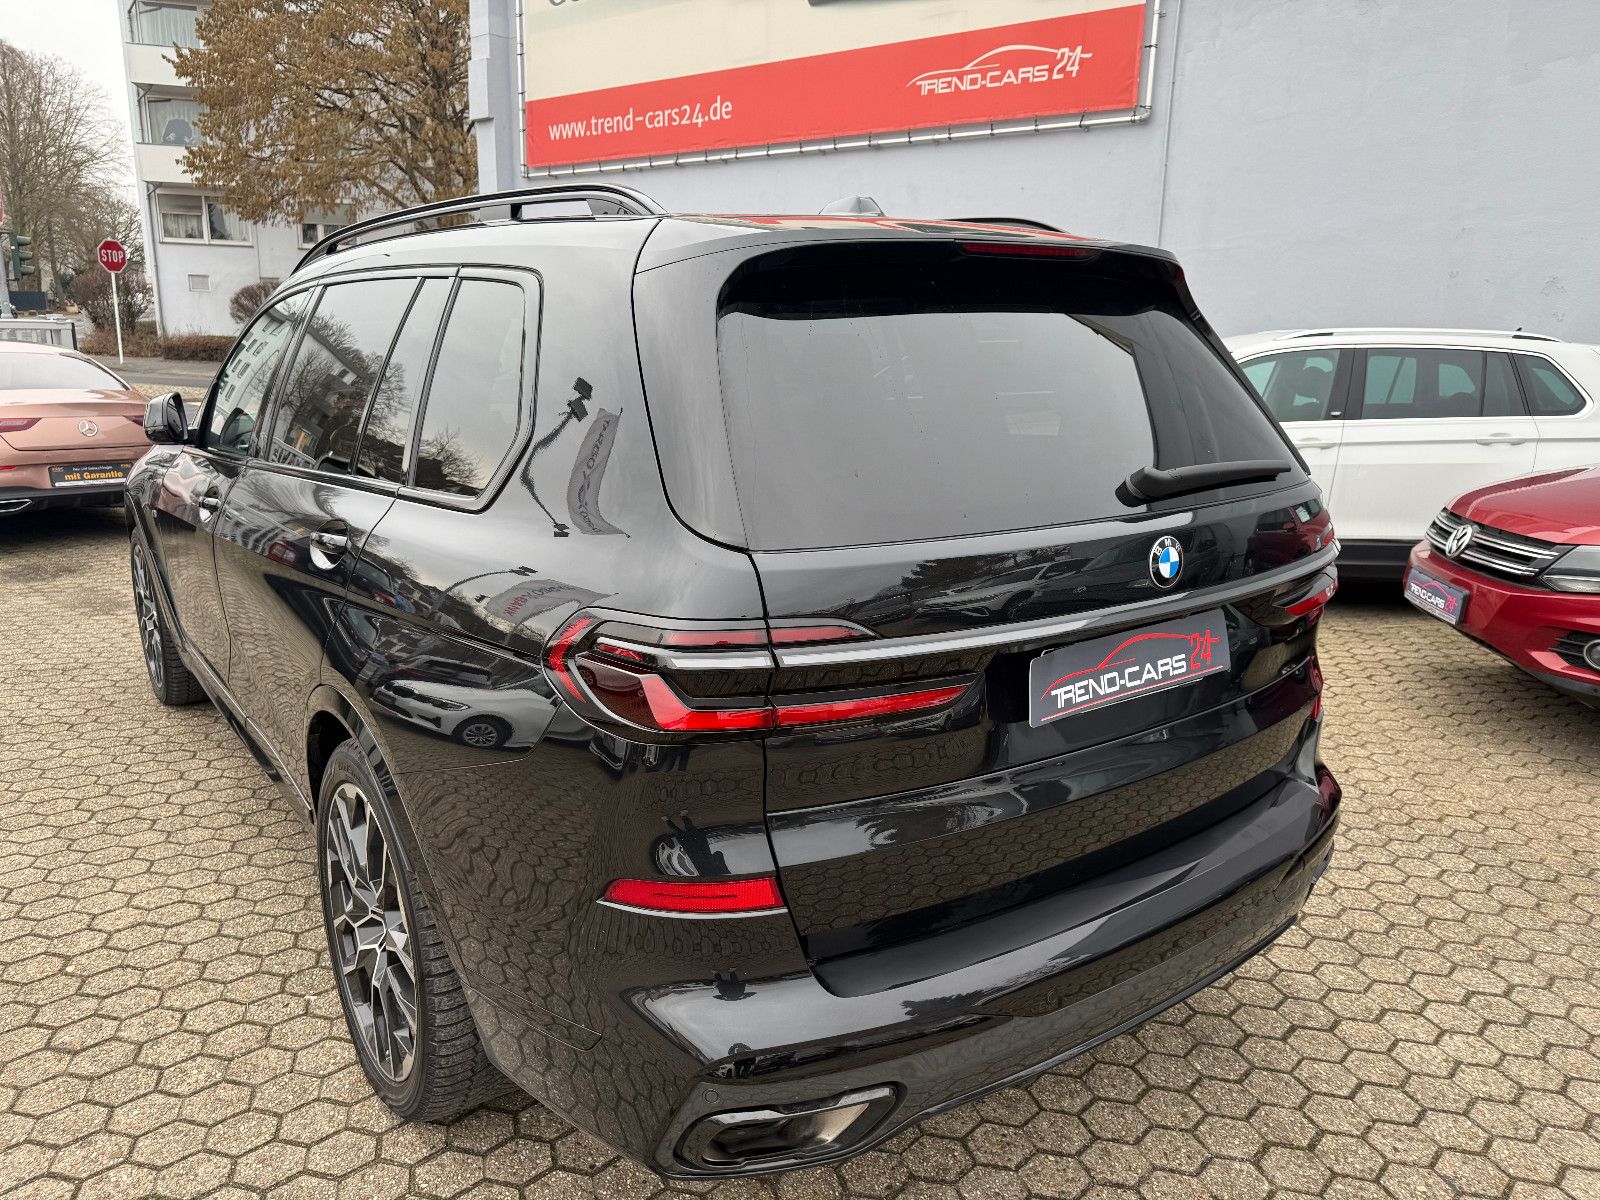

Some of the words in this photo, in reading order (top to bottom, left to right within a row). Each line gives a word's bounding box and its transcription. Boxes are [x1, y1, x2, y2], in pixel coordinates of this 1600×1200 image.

[915, 64, 1049, 96] TREND-CARS
[548, 95, 733, 141] www.trend-cars24.de
[101, 249, 124, 263] STOP
[83, 470, 124, 480] Garantie
[1051, 653, 1187, 709] TREND-CARS
[1189, 629, 1221, 671] 24
